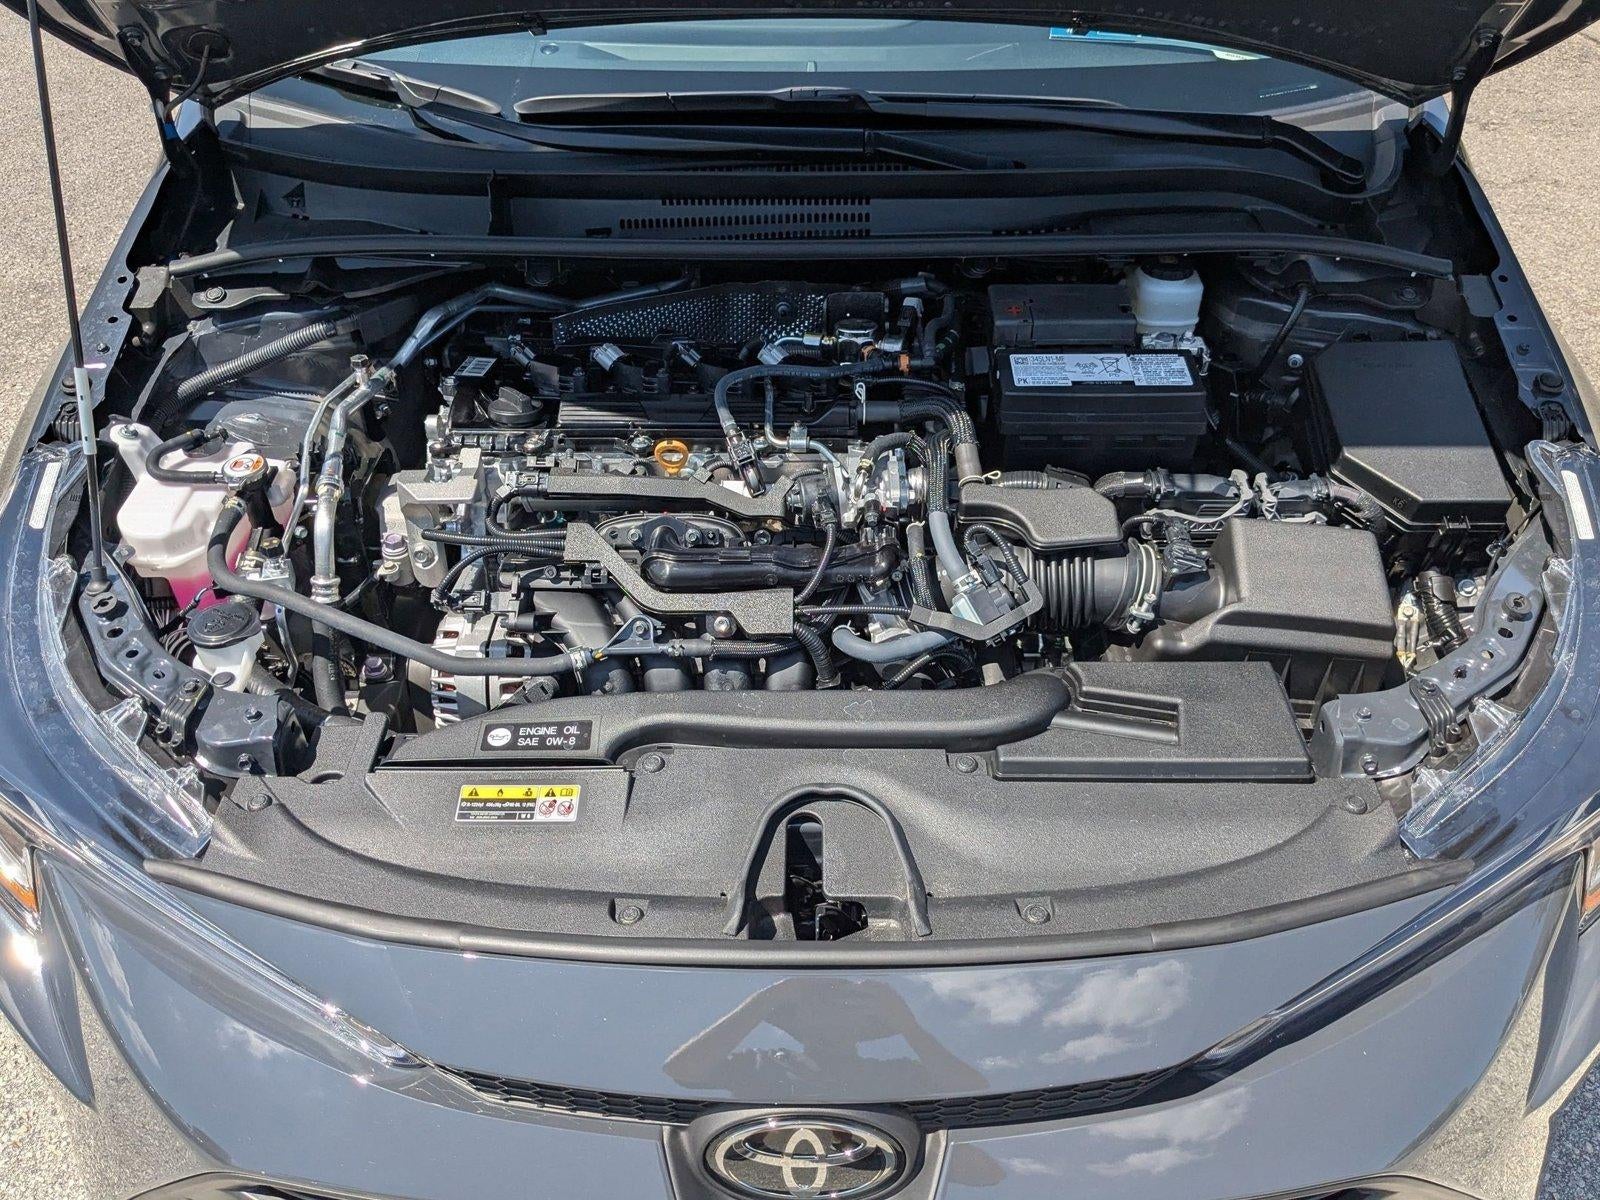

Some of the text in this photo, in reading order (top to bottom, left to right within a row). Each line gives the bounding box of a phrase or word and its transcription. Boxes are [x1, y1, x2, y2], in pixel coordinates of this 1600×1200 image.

[1017, 377, 1029, 385] PK
[519, 725, 580, 736] ENGINE OIL
[517, 736, 576, 746] SAE 0W-8
